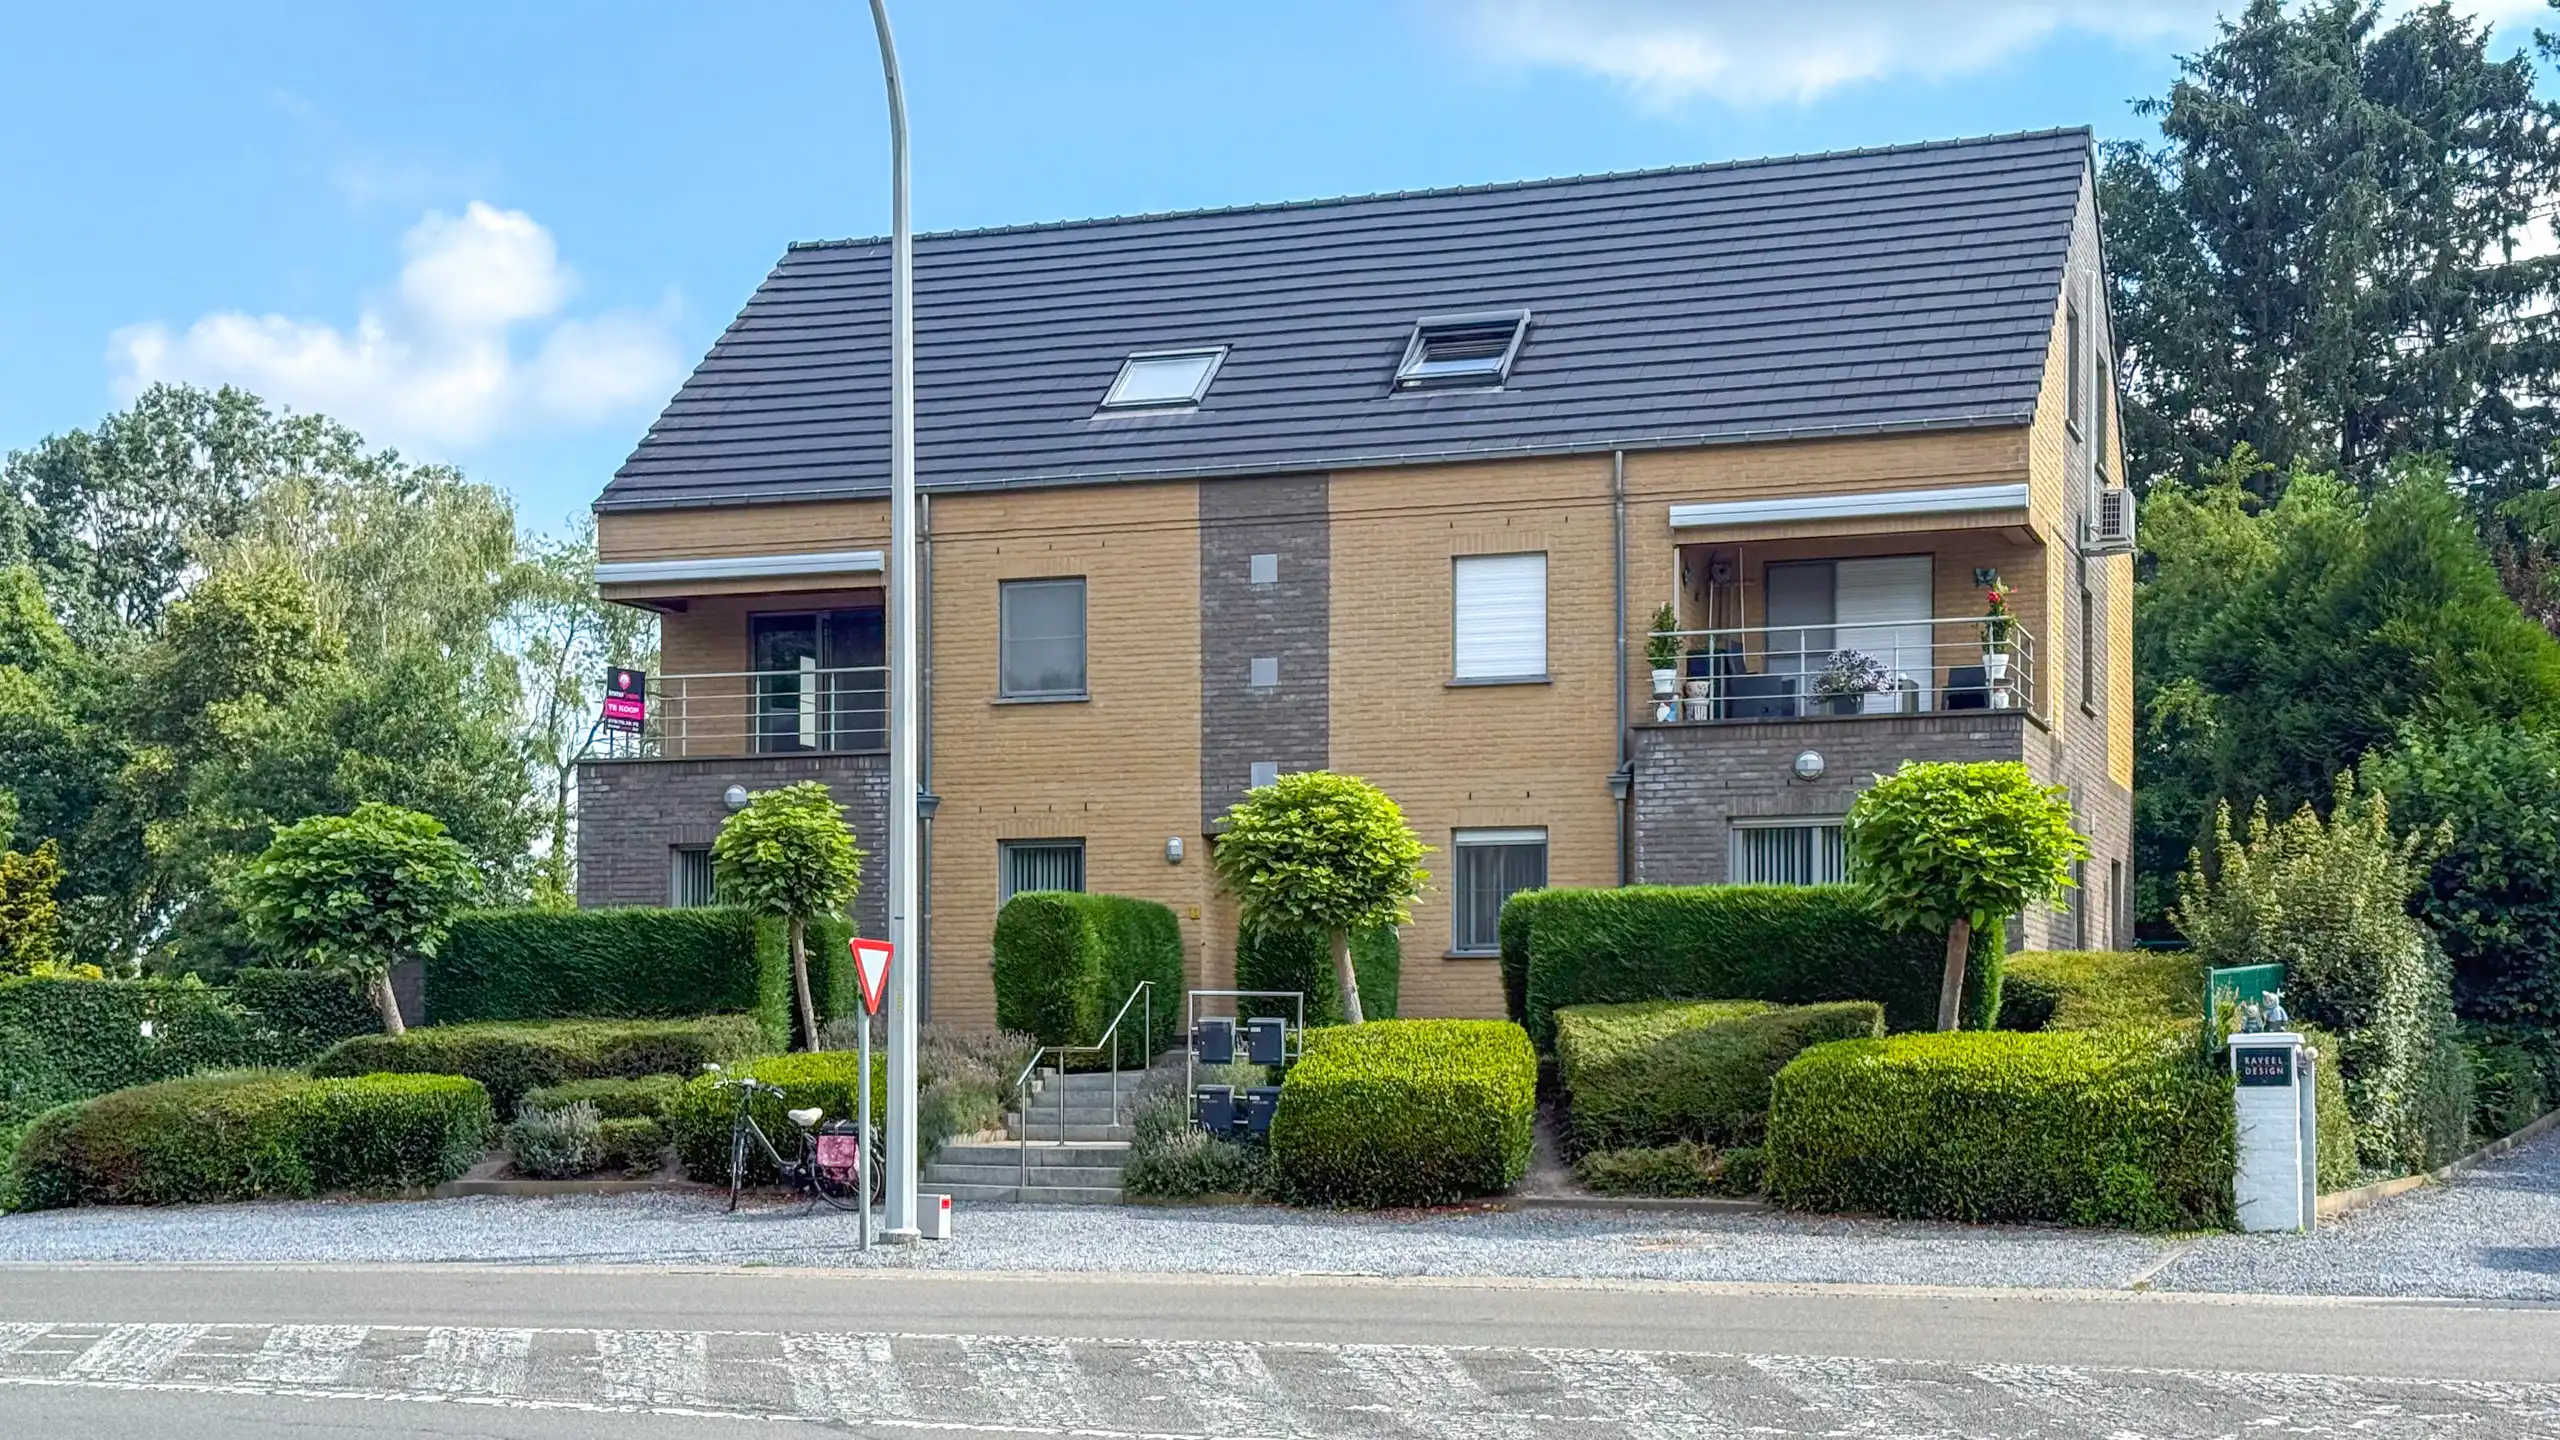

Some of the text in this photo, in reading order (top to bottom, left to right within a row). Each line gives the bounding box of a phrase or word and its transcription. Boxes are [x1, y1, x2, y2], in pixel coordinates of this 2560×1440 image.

[608, 703, 639, 713] TE KOOP
[2244, 1056, 2283, 1065] RAVEEL
[2245, 1067, 2284, 1075] DESIGN
